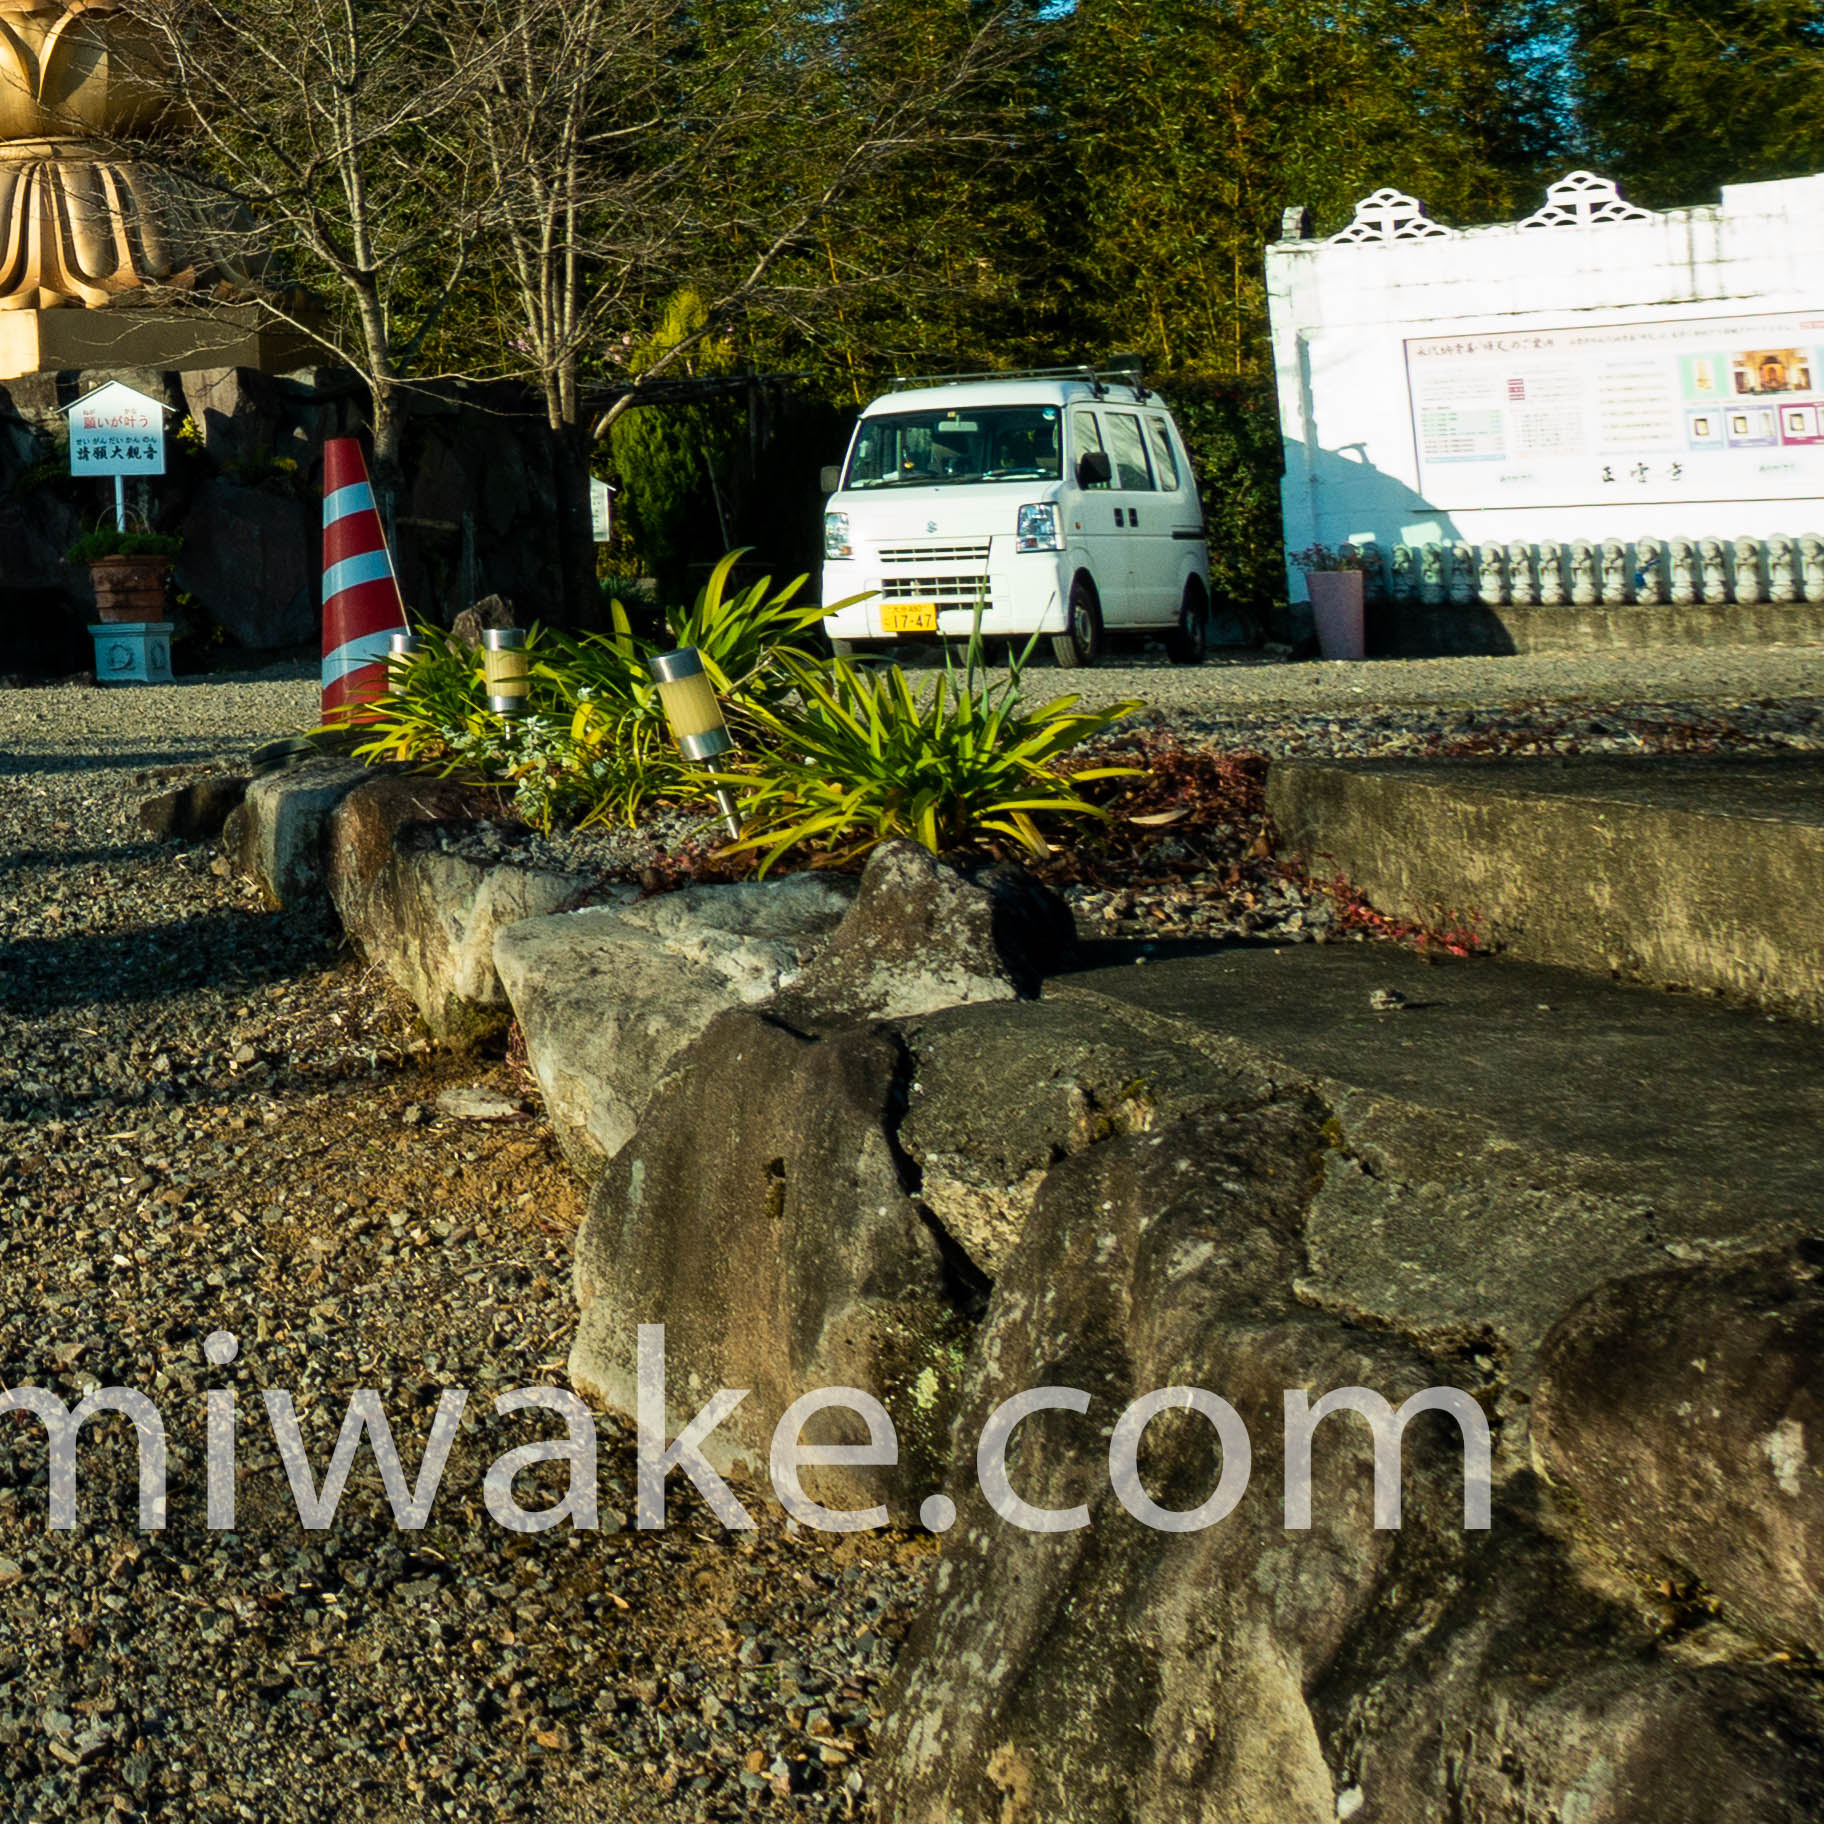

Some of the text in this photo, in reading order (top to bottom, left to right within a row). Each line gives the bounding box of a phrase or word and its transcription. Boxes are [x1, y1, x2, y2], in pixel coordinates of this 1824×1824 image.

[83, 415, 149, 429] 願いが叶う
[894, 614, 932, 628] 17-47
